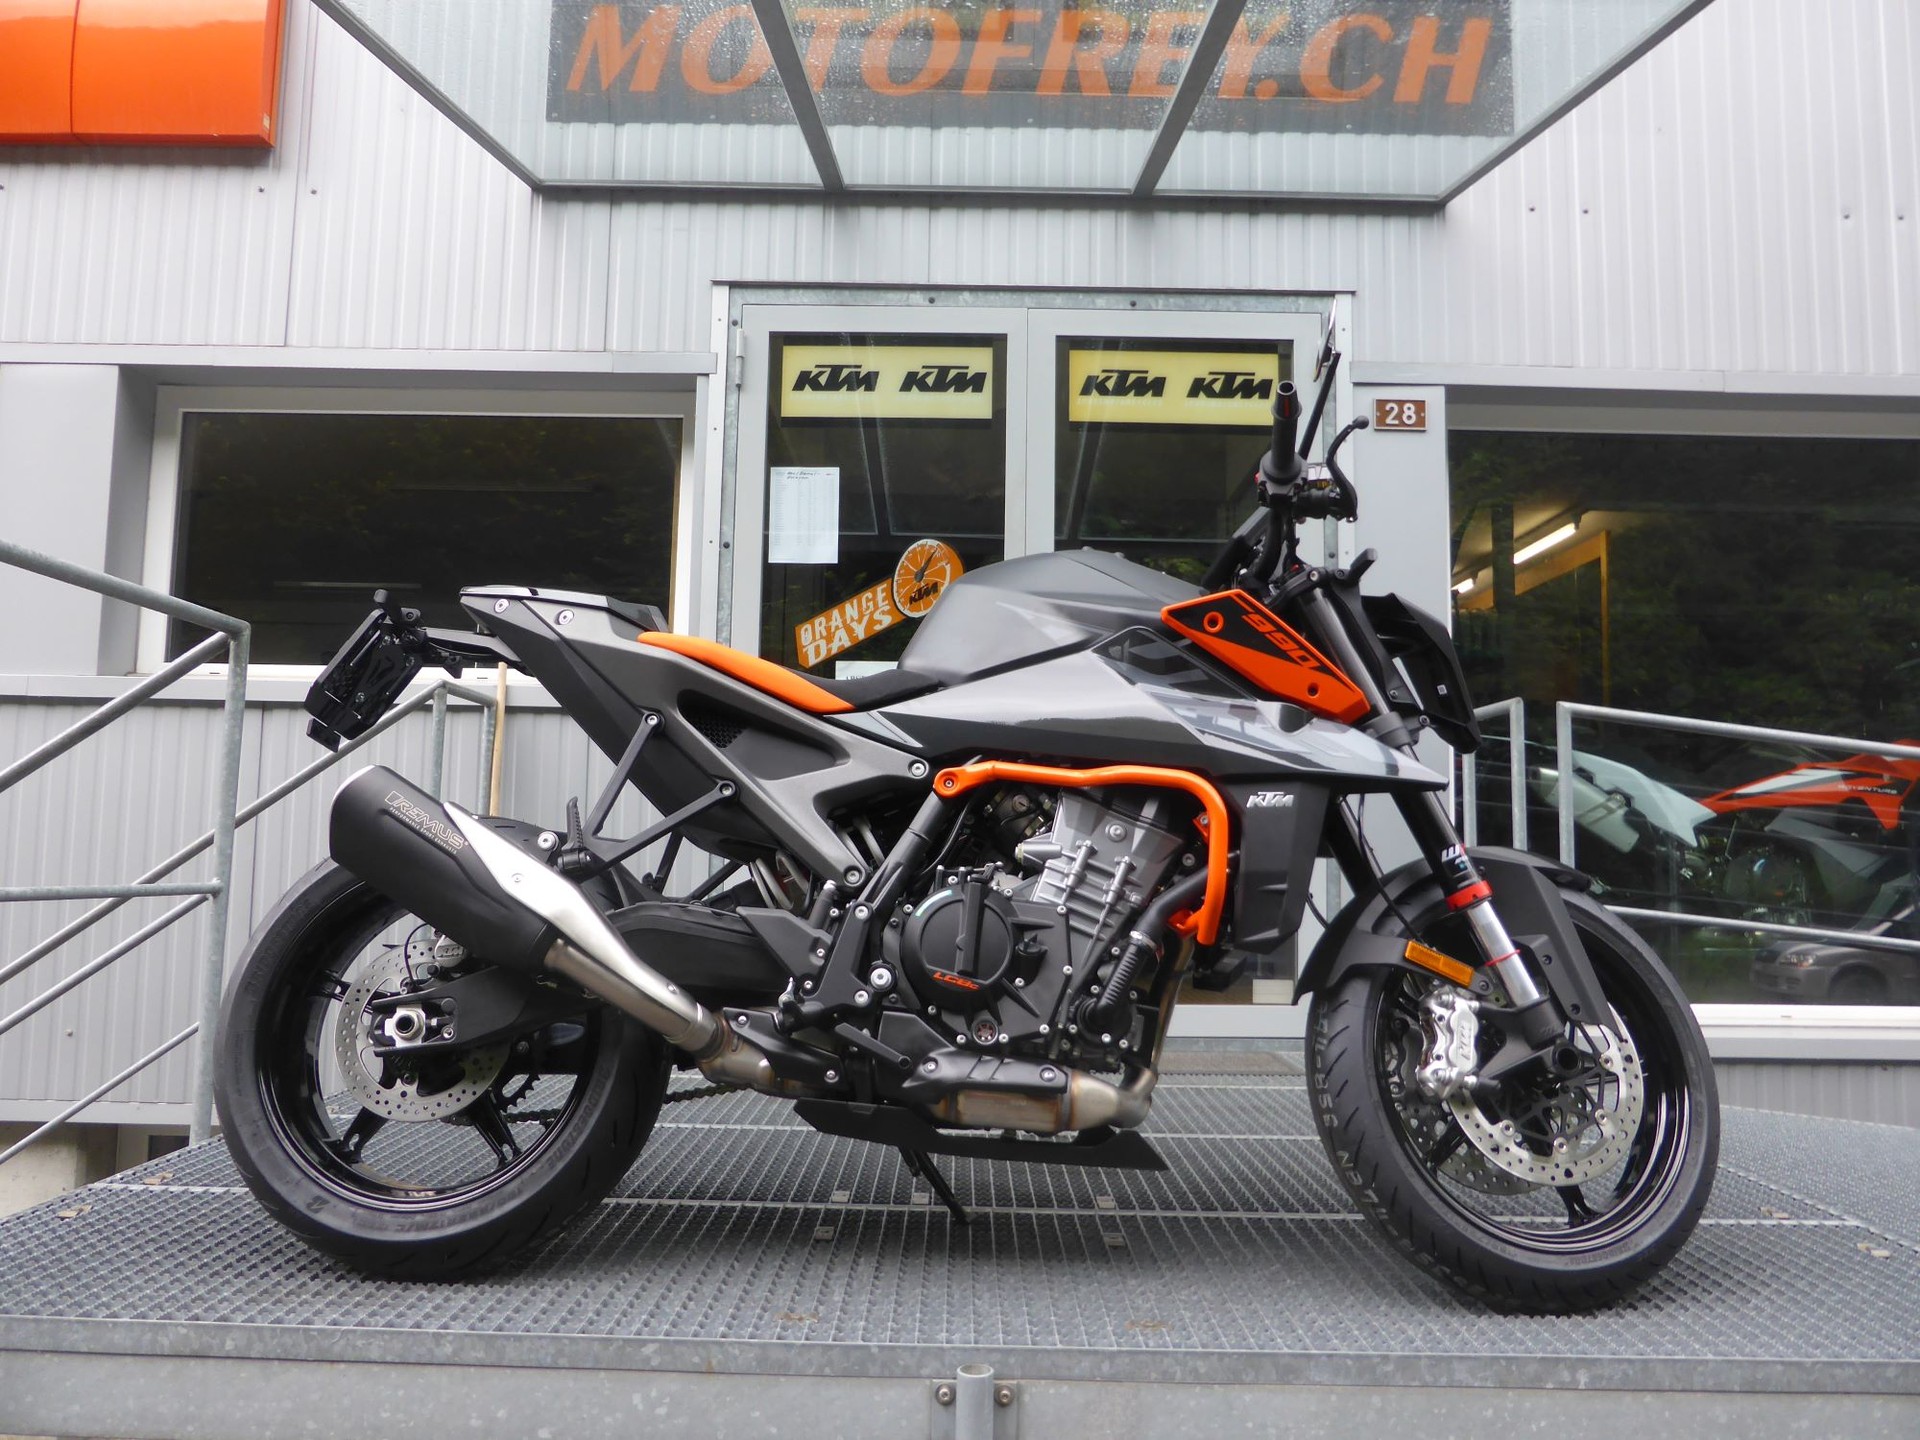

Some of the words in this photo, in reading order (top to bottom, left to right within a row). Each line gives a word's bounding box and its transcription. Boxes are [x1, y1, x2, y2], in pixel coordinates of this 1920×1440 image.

[565, 3, 1492, 105] MOTOFREY.CH
[791, 364, 880, 392] KTM
[898, 365, 988, 393] KTM
[1078, 369, 1167, 398] KTM
[1186, 371, 1274, 400] KTM
[1385, 402, 1416, 425] 28
[909, 581, 939, 605] KTM
[800, 583, 890, 647] ORANGE
[802, 604, 893, 667] DAYS
[1240, 613, 1321, 668] 990
[1246, 791, 1294, 808] KTM
[392, 798, 465, 850] REMUS
